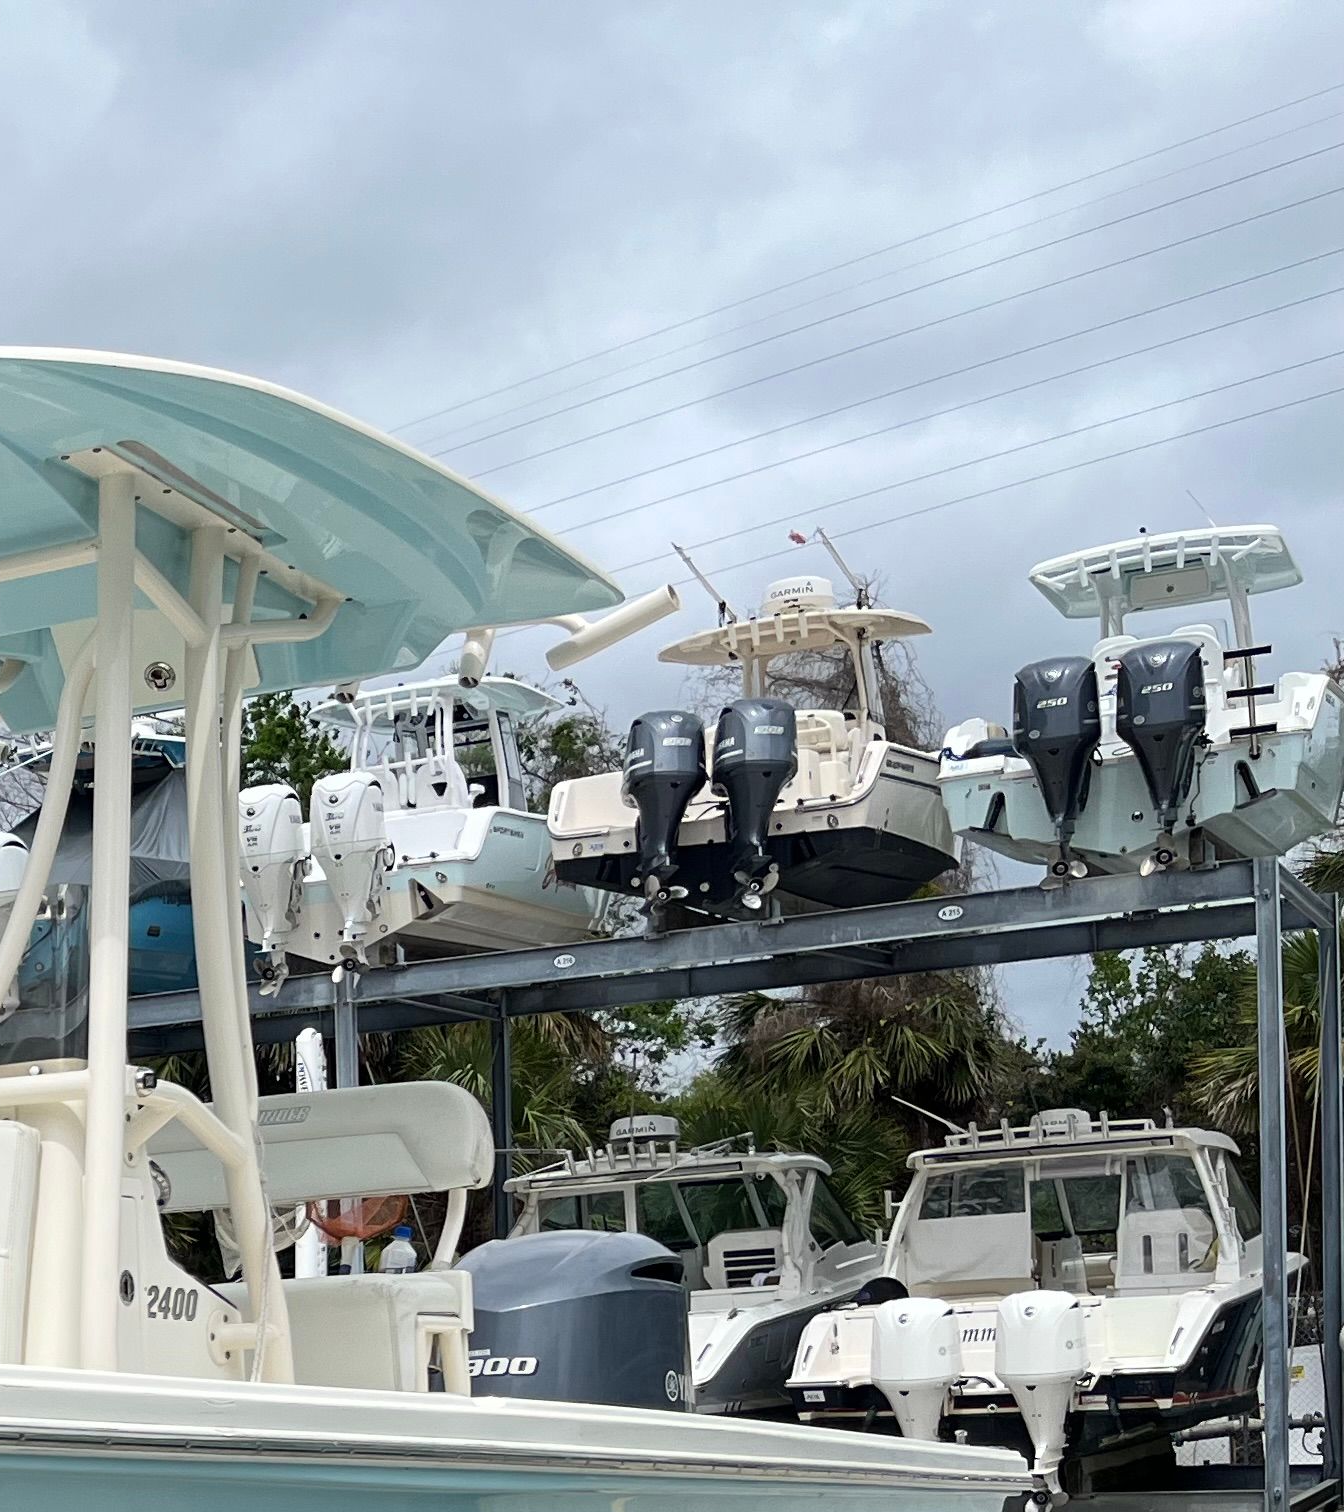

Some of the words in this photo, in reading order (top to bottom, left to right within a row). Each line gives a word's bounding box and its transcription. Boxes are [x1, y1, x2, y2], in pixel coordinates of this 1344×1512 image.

[770, 586, 814, 599] GARMIN
[1141, 682, 1173, 695] 250
[1036, 697, 1068, 709] 250
[147, 1285, 198, 1321] 2400
